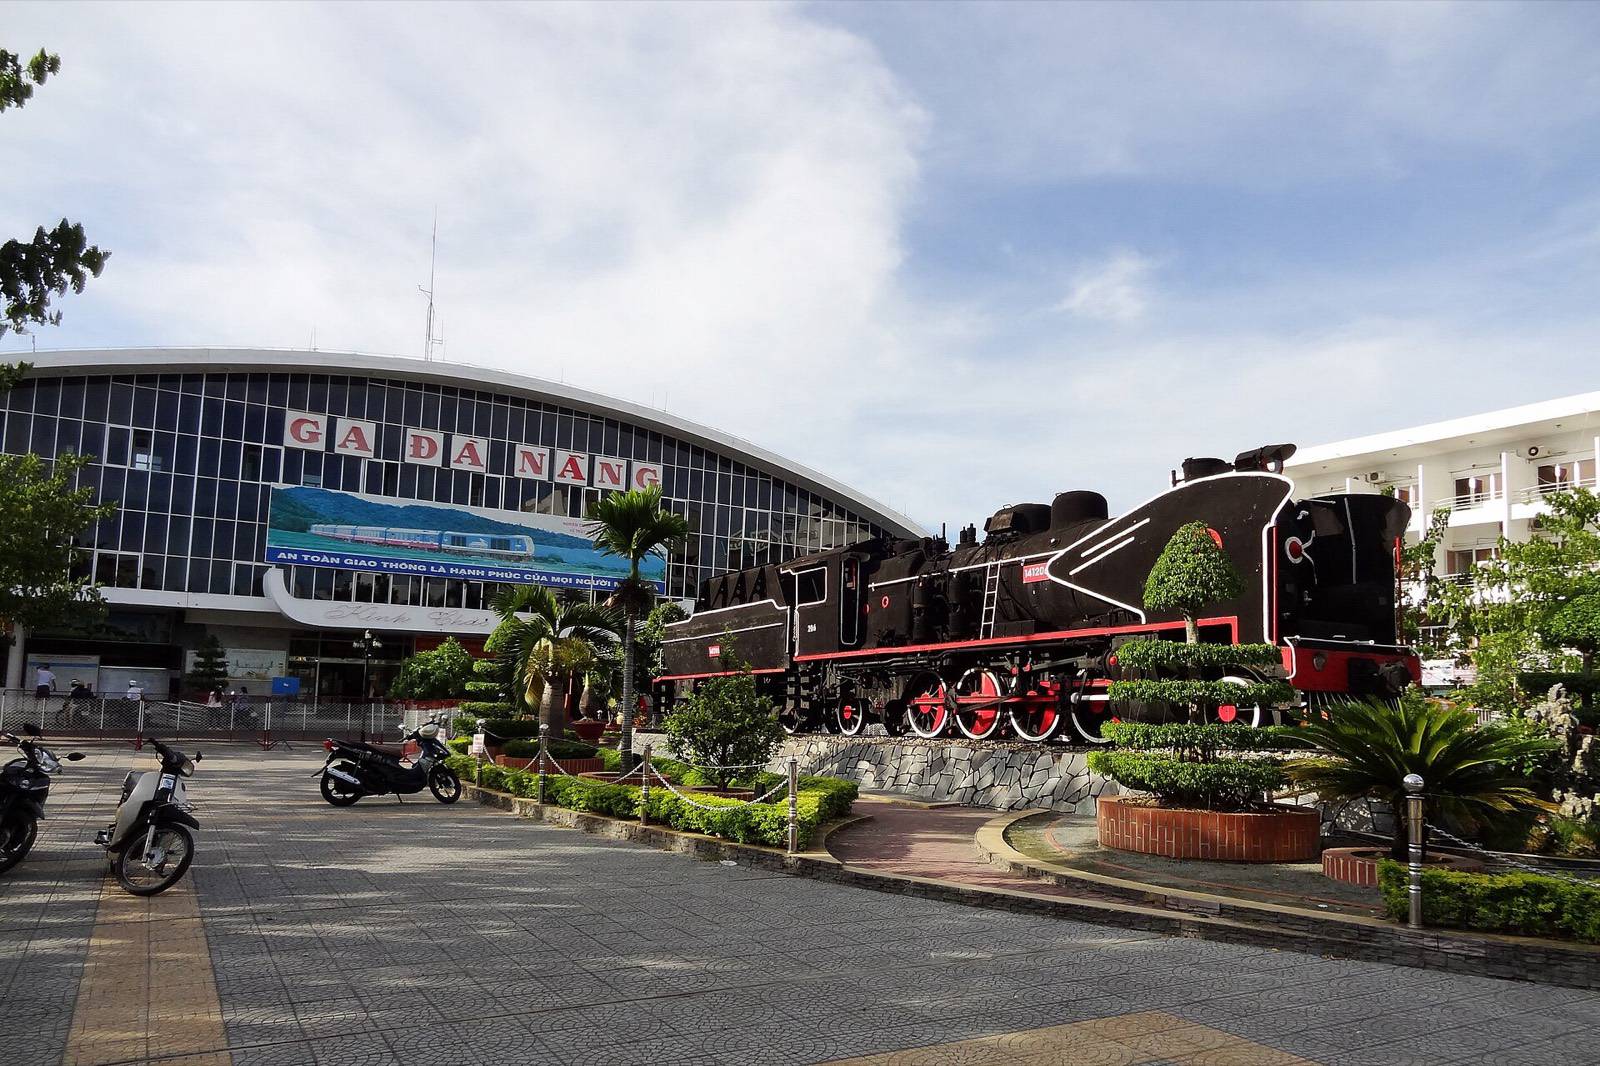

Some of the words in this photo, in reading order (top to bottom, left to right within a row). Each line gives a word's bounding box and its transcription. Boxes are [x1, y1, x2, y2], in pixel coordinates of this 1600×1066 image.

[290, 418, 372, 452] GA
[277, 552, 298, 560] AN
[301, 554, 340, 564] TOÀN
[344, 558, 377, 567] GIAO
[381, 561, 427, 572] THÔNG
[430, 563, 446, 573] LÀ
[449, 567, 485, 576] HẠNH
[488, 570, 521, 579] PHÚC
[523, 572, 548, 582] CỦA
[551, 576, 573, 585] MỌI
[576, 578, 611, 588] NGƯỜI
